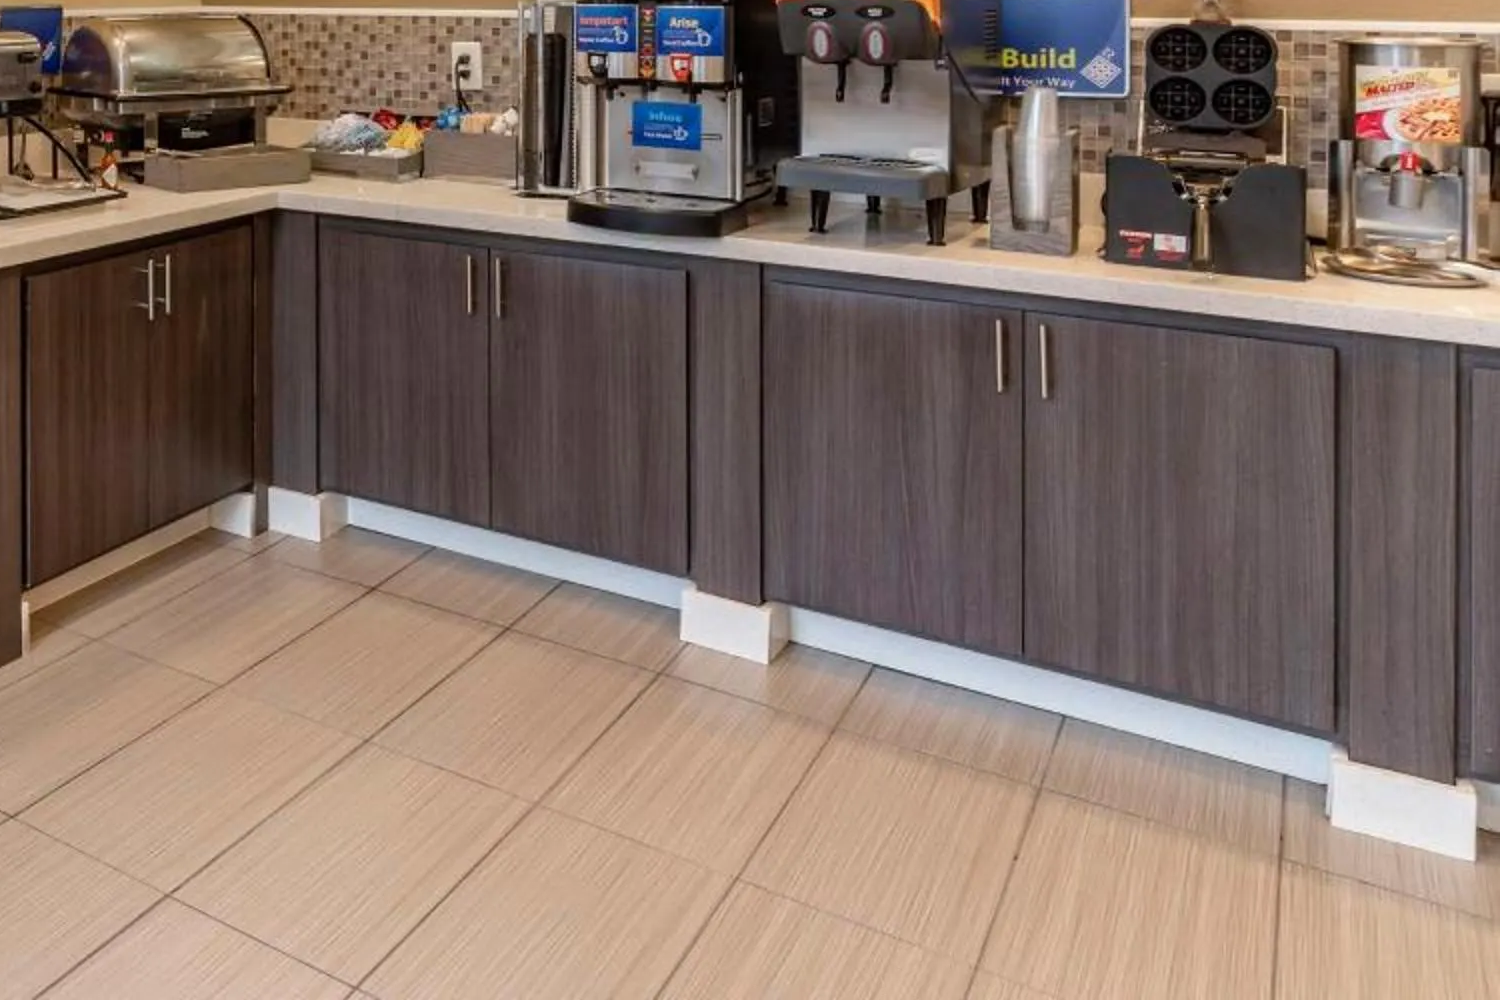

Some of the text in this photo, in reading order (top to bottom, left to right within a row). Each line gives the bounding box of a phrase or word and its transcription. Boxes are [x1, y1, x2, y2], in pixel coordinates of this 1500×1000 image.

[669, 16, 700, 29] Arise
[1002, 47, 1077, 69] Build
[1047, 76, 1077, 88] Way
